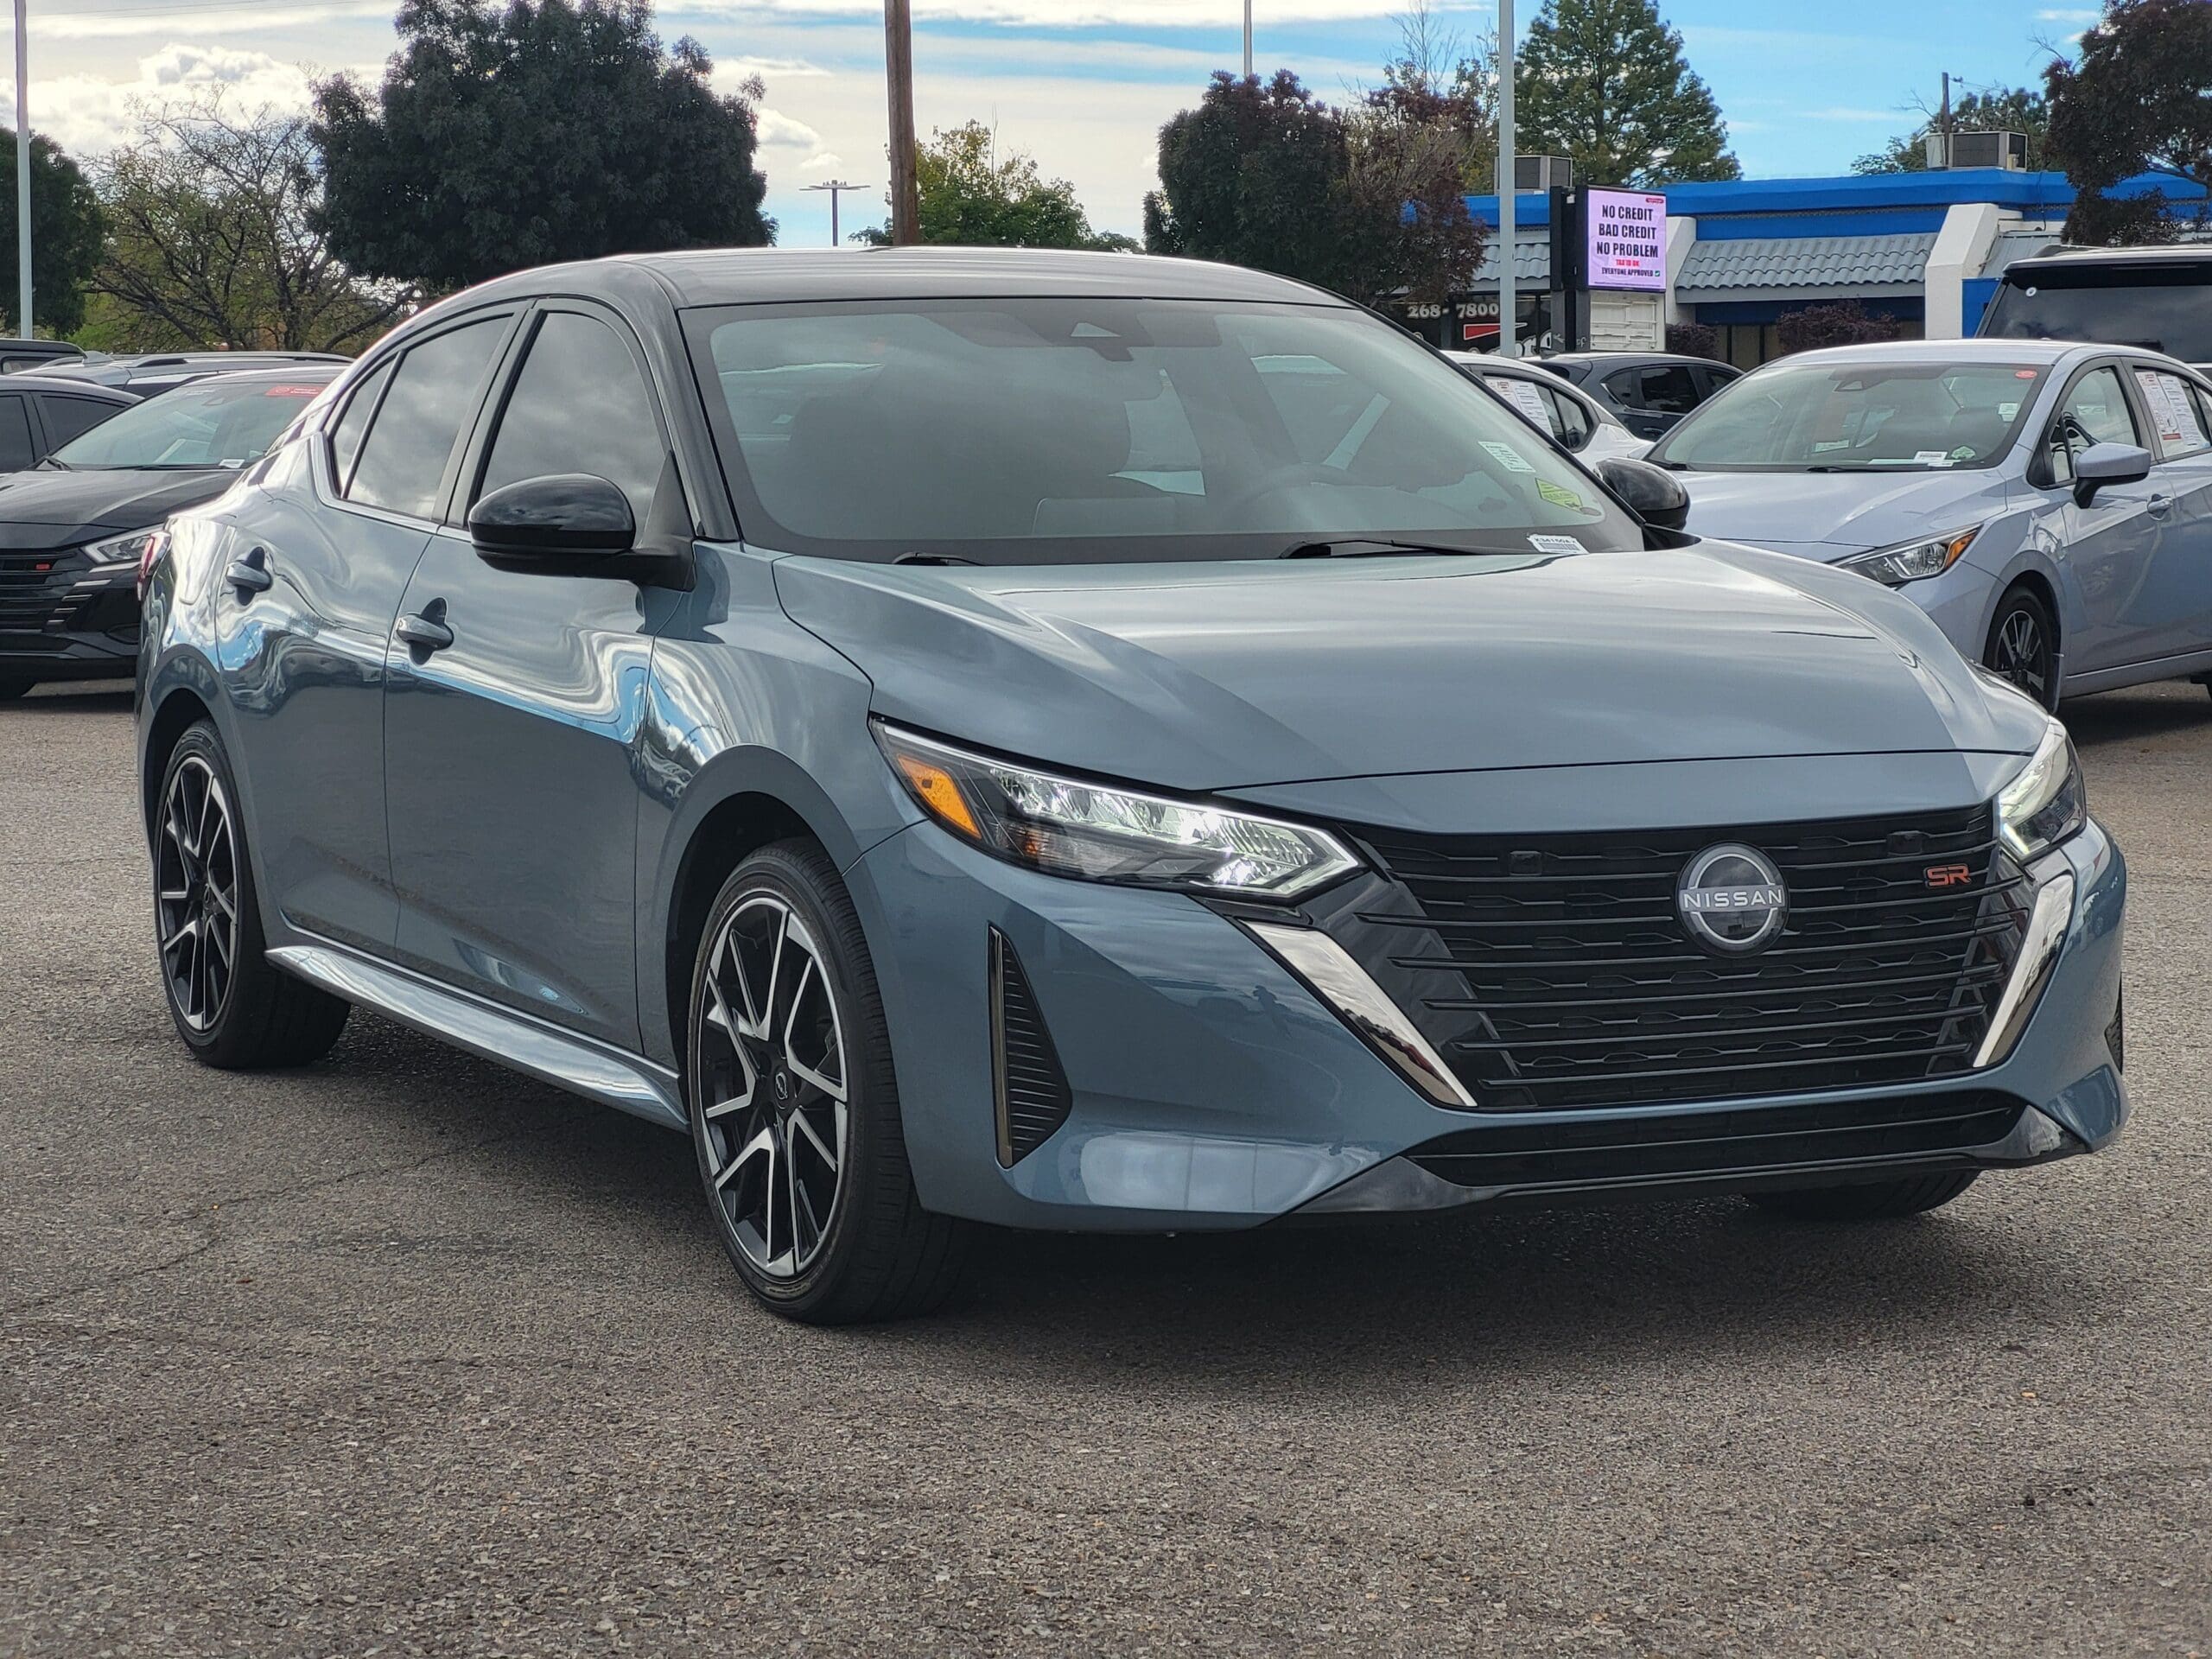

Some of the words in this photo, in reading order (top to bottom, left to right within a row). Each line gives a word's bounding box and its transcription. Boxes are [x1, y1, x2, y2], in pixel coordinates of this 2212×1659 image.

[1602, 205, 1615, 219] NO
[1618, 206, 1653, 221] CREDIT
[1599, 223, 1618, 237] BAD
[1622, 225, 1656, 239] CREDIT
[1597, 242, 1610, 255] NO
[1613, 243, 1658, 257] PROBLEM
[1456, 303, 1499, 319] 7800
[1927, 865, 1971, 887] SR
[1683, 889, 1783, 908] NISSAN
